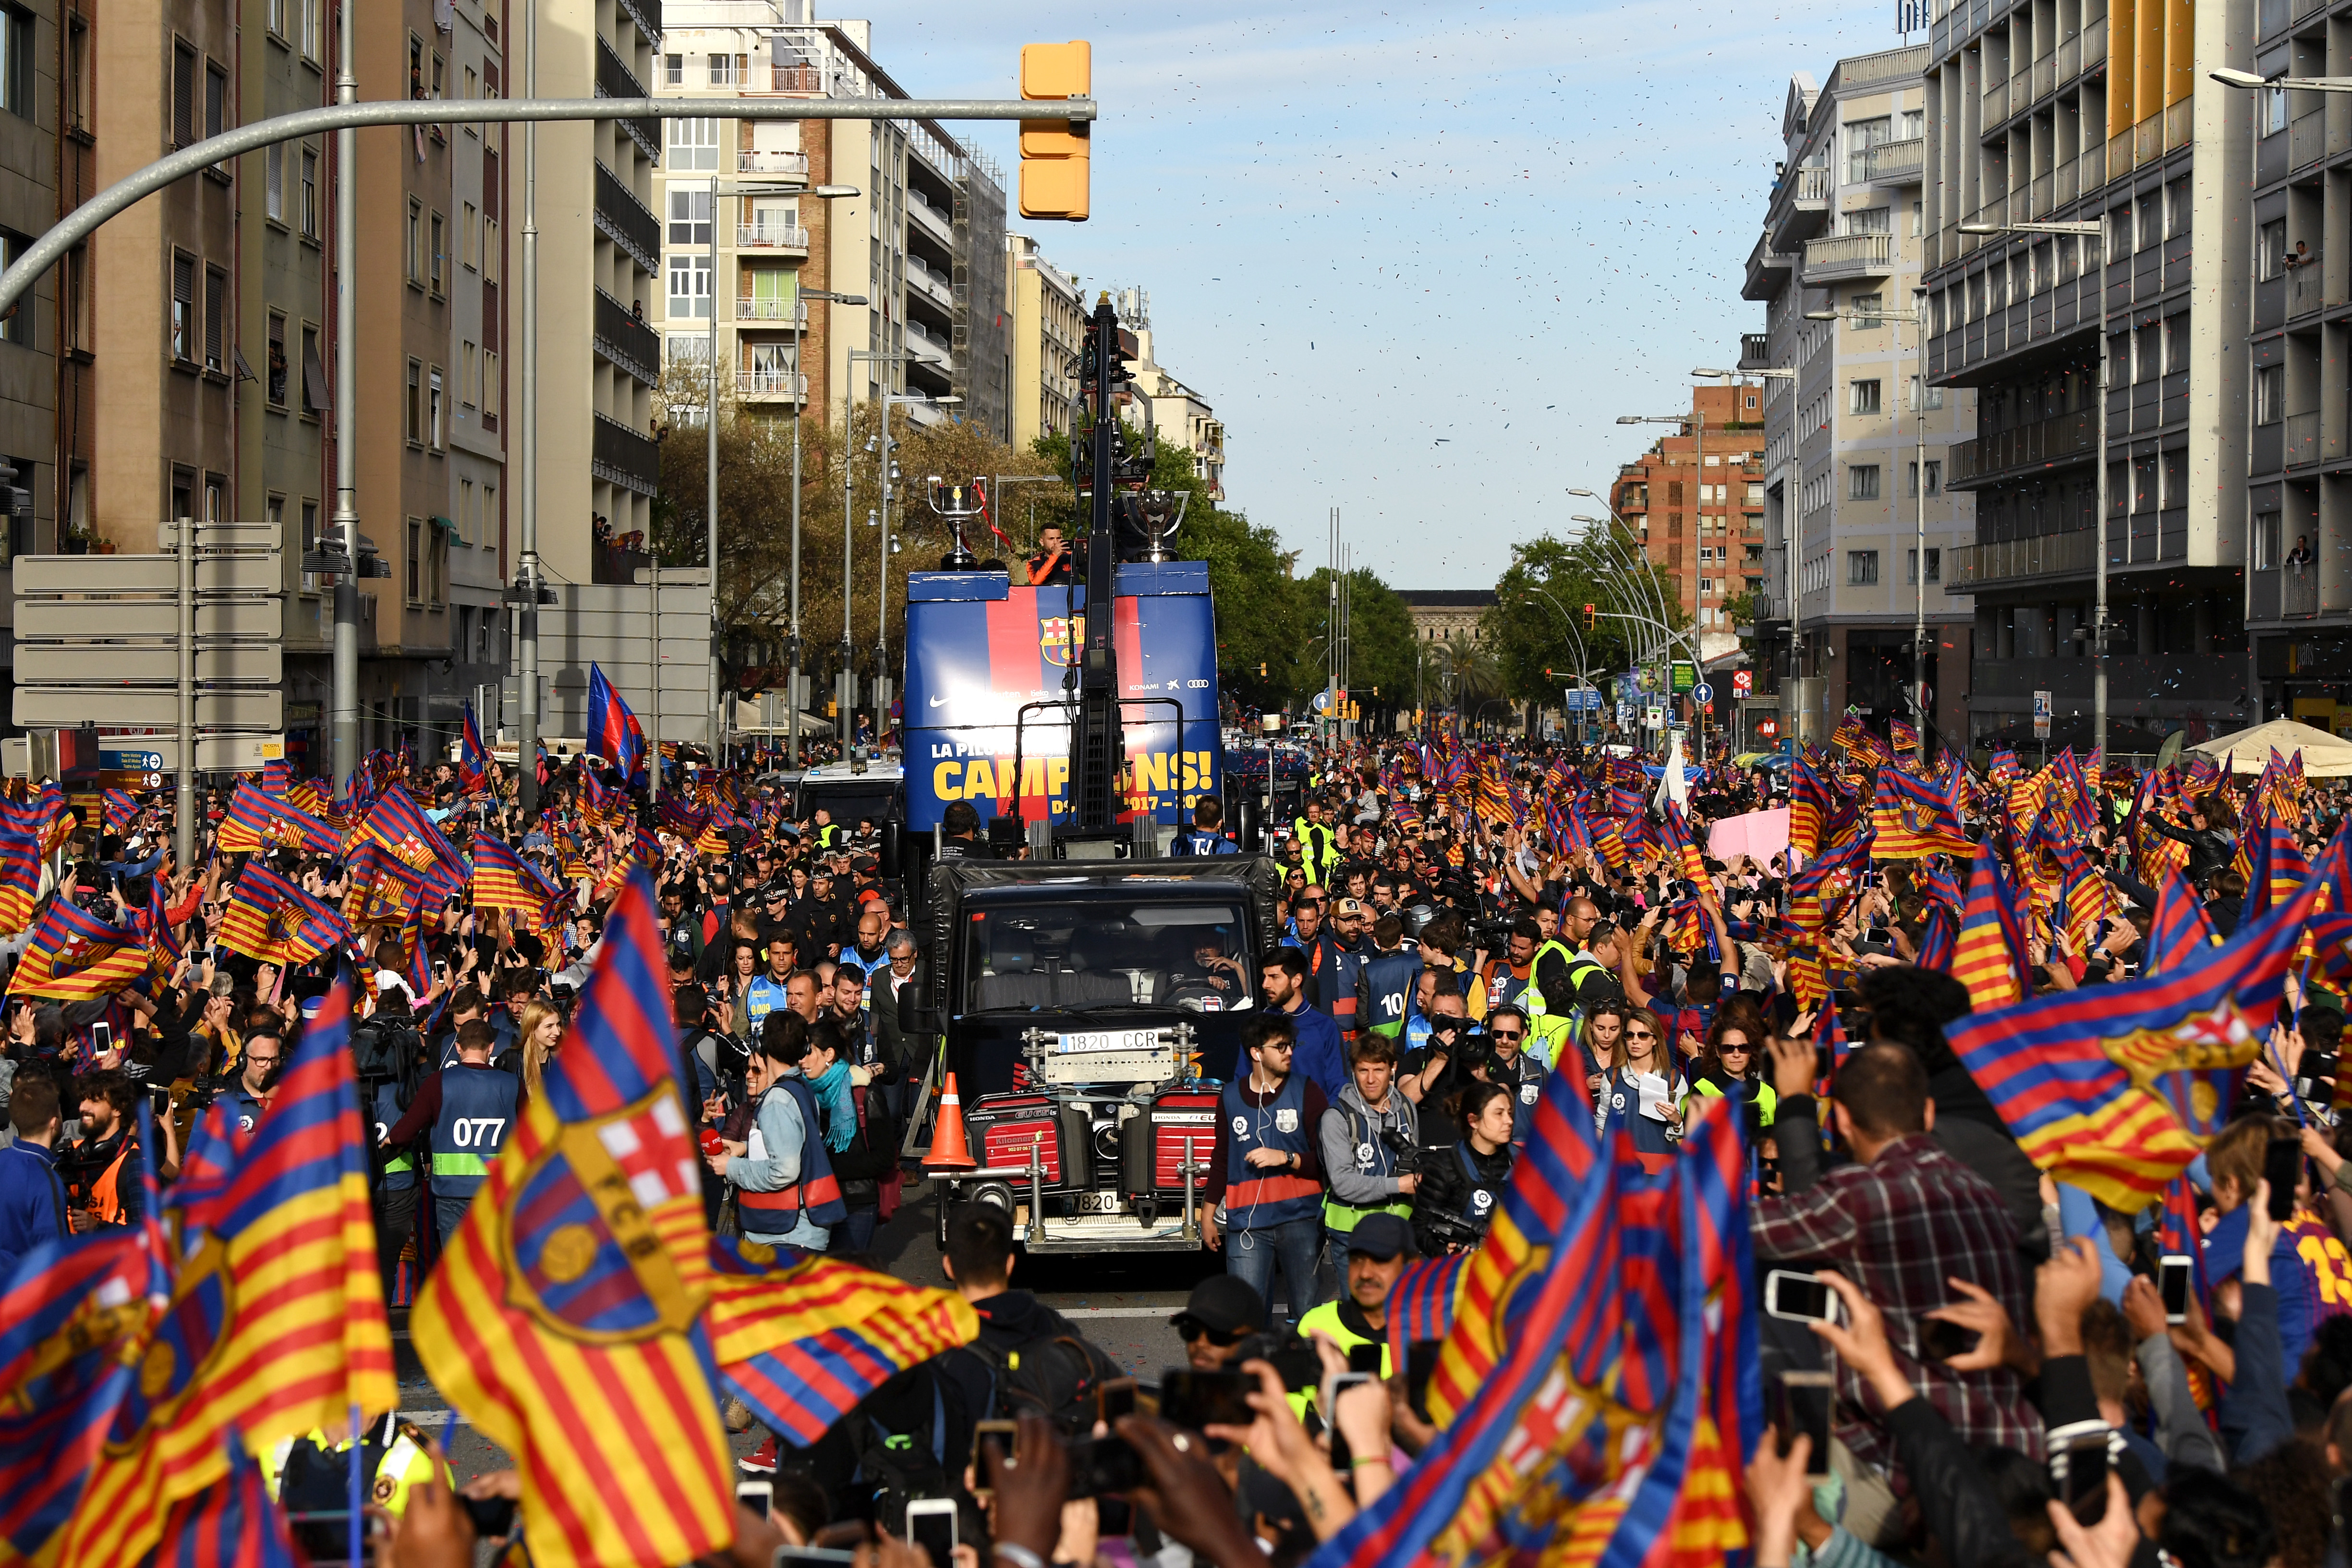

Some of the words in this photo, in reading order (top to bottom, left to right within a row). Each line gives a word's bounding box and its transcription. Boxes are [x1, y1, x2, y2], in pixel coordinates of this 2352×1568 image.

[2036, 699, 2041, 710] P
[1626, 707, 1633, 717] P
[1763, 723, 1775, 733] M
[931, 743, 953, 758] LA
[934, 751, 1212, 801] CAMPNS!
[274, 835, 291, 847] FCB
[1193, 838, 1213, 856] TJ
[371, 888, 388, 900] FCB
[72, 957, 90, 965] FCB
[1071, 1034, 1109, 1050] 1820
[1123, 1032, 1155, 1047] CCR
[453, 1118, 505, 1147] 077
[1080, 1194, 1113, 1211] 820
